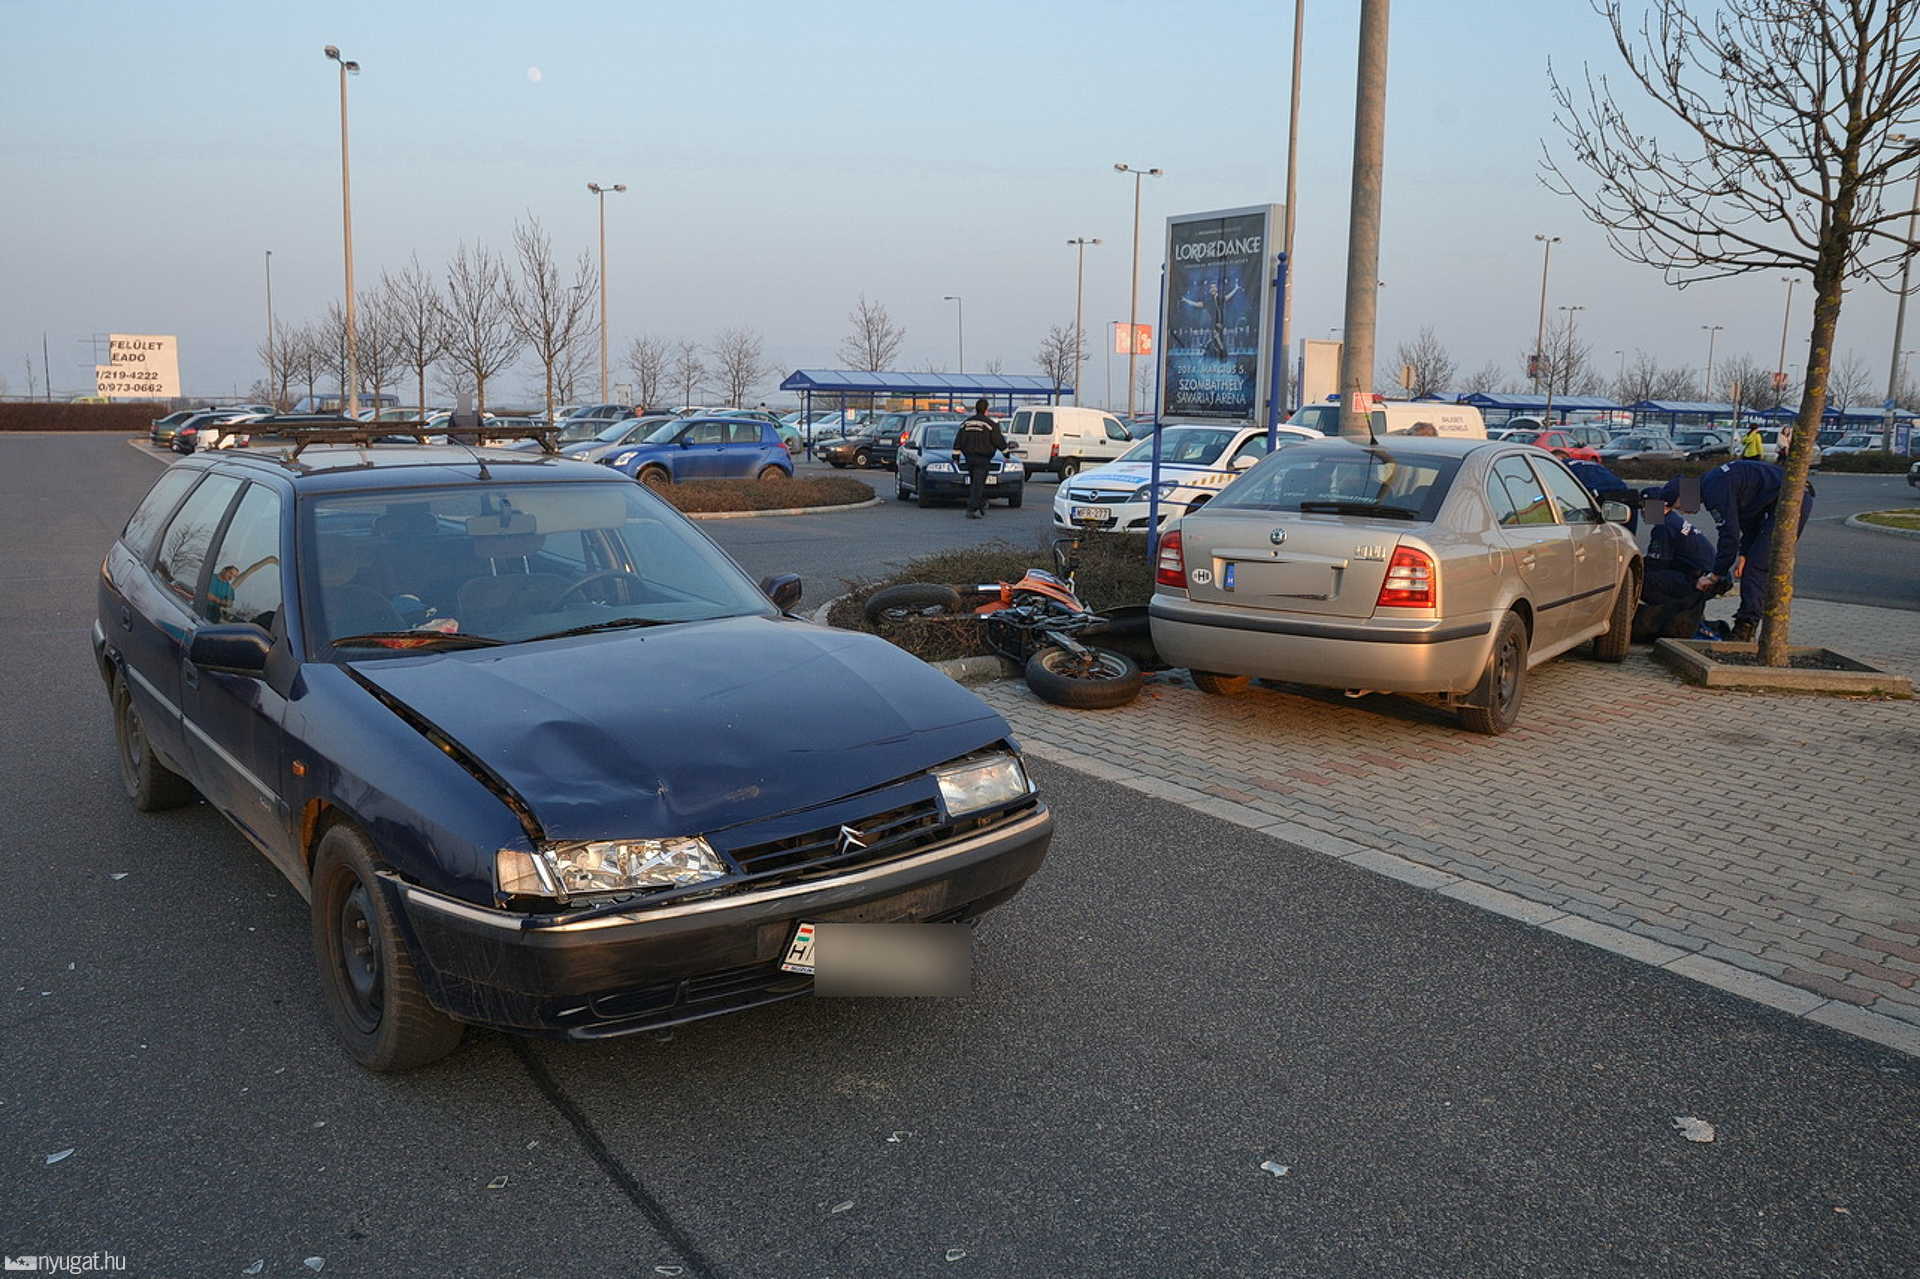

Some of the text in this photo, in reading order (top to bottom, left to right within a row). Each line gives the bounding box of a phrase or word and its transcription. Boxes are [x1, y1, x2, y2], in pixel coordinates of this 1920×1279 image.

[1175, 242, 1206, 262] LORD
[1217, 236, 1261, 257] DANCE
[1178, 378, 1244, 392] SZOMBATHELY
